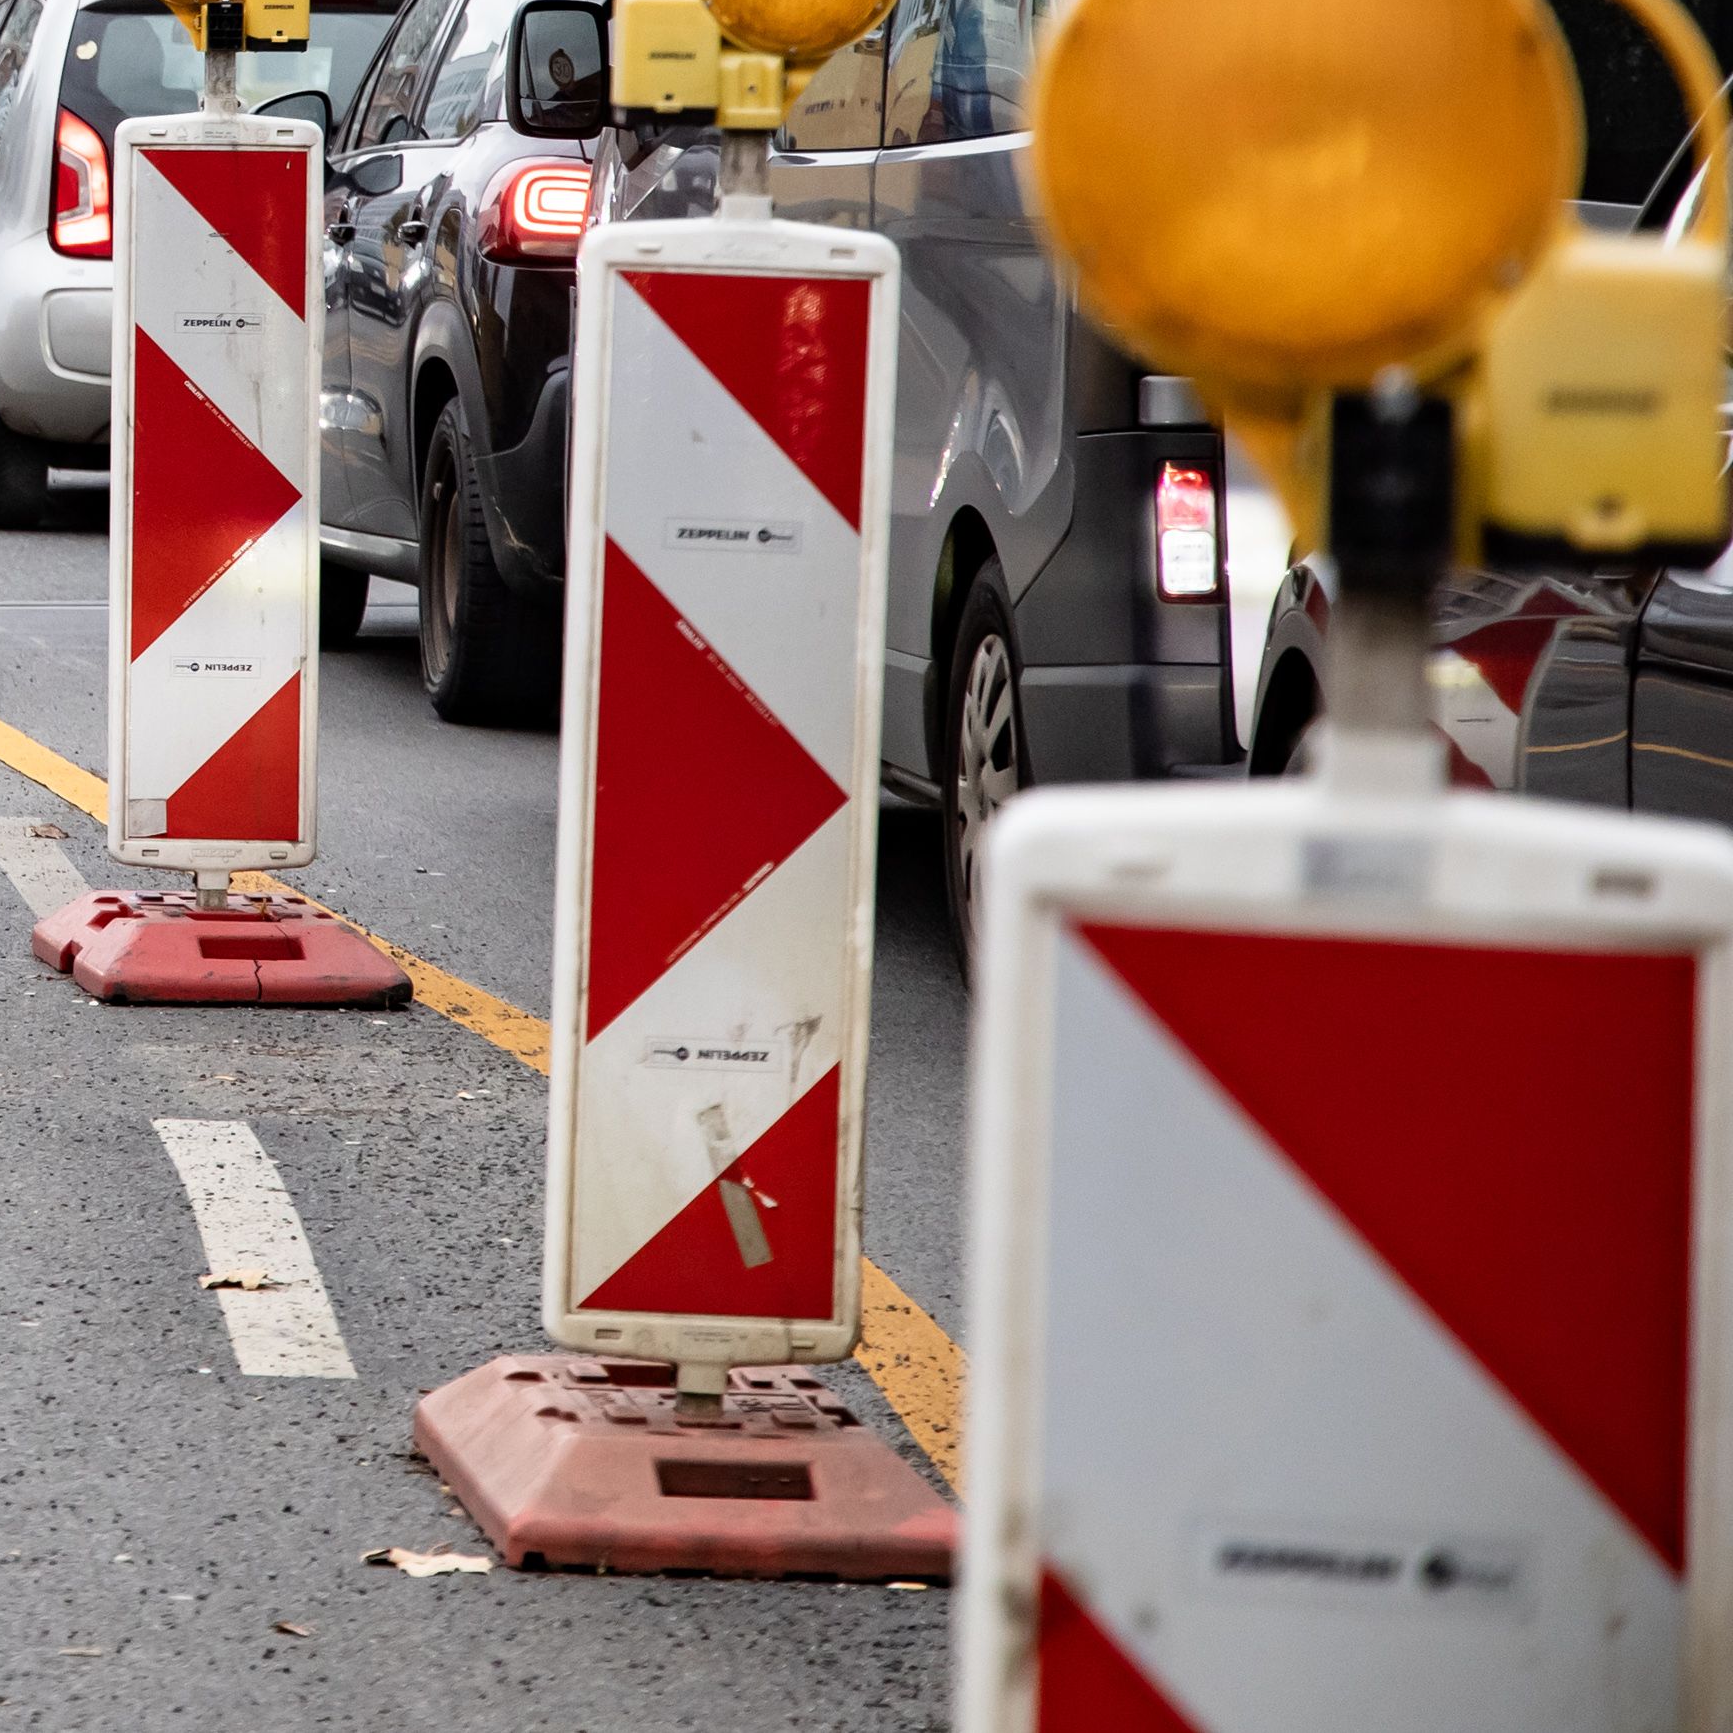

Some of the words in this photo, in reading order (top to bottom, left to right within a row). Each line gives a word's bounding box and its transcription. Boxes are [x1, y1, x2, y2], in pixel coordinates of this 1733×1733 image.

[183, 319, 232, 327] ZEPPELIN
[677, 528, 751, 540] ZEPPELIN
[204, 663, 253, 672] ZEPPELIN
[697, 1049, 770, 1062] ZEPPELIN
